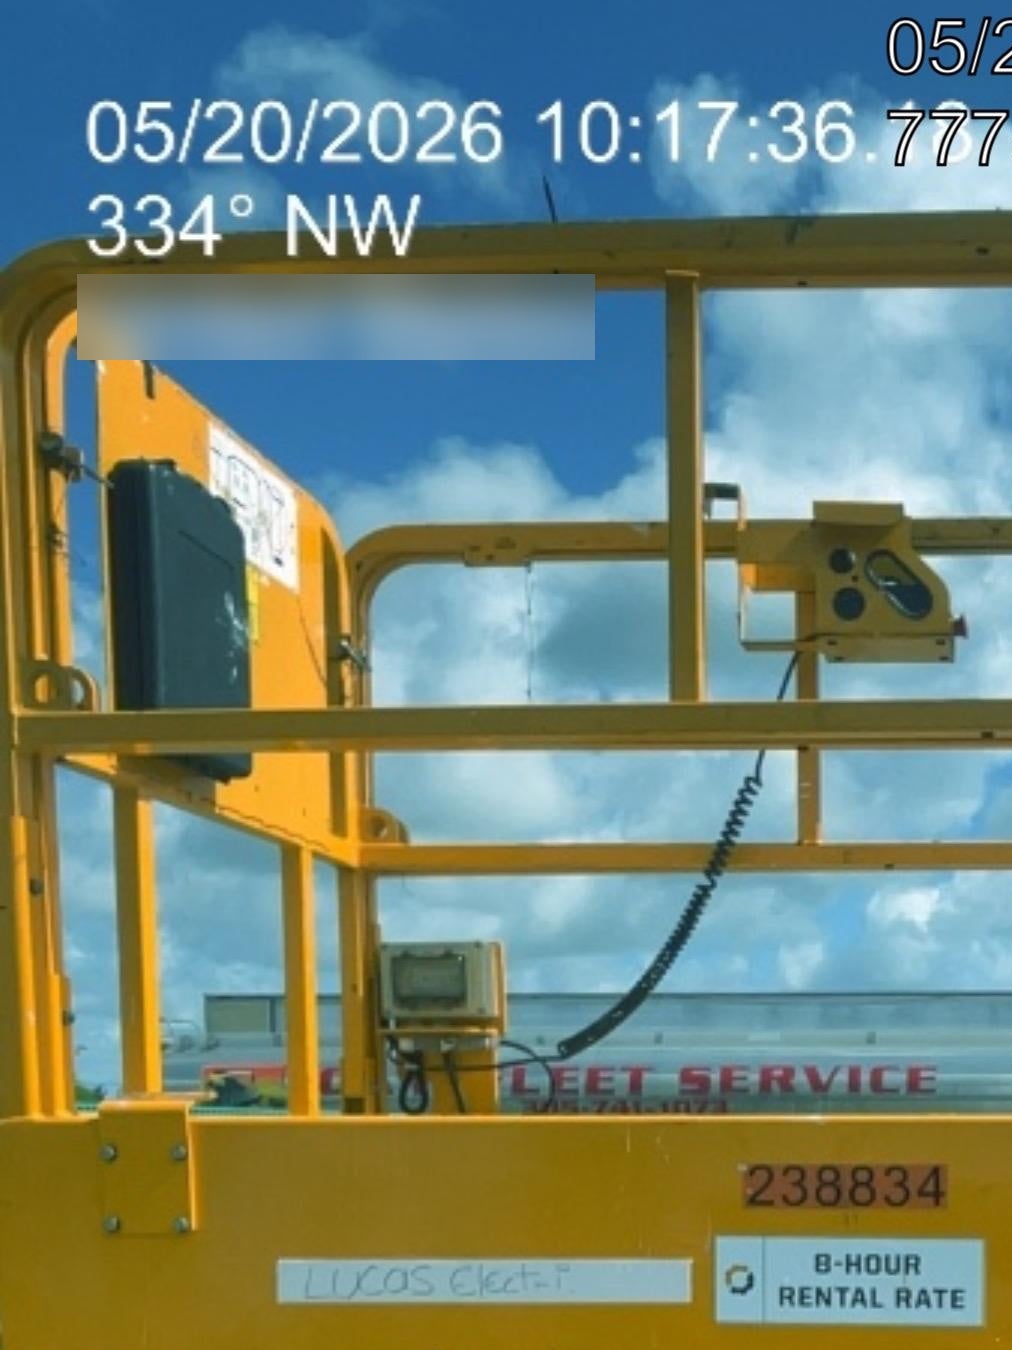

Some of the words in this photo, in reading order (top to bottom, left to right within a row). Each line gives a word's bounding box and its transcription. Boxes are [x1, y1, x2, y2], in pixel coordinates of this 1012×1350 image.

[678, 1064, 938, 1096] SERVICE
[746, 1163, 945, 1208] 238834
[778, 1286, 883, 1309] RENTAL
[894, 1287, 967, 1310] RATE
